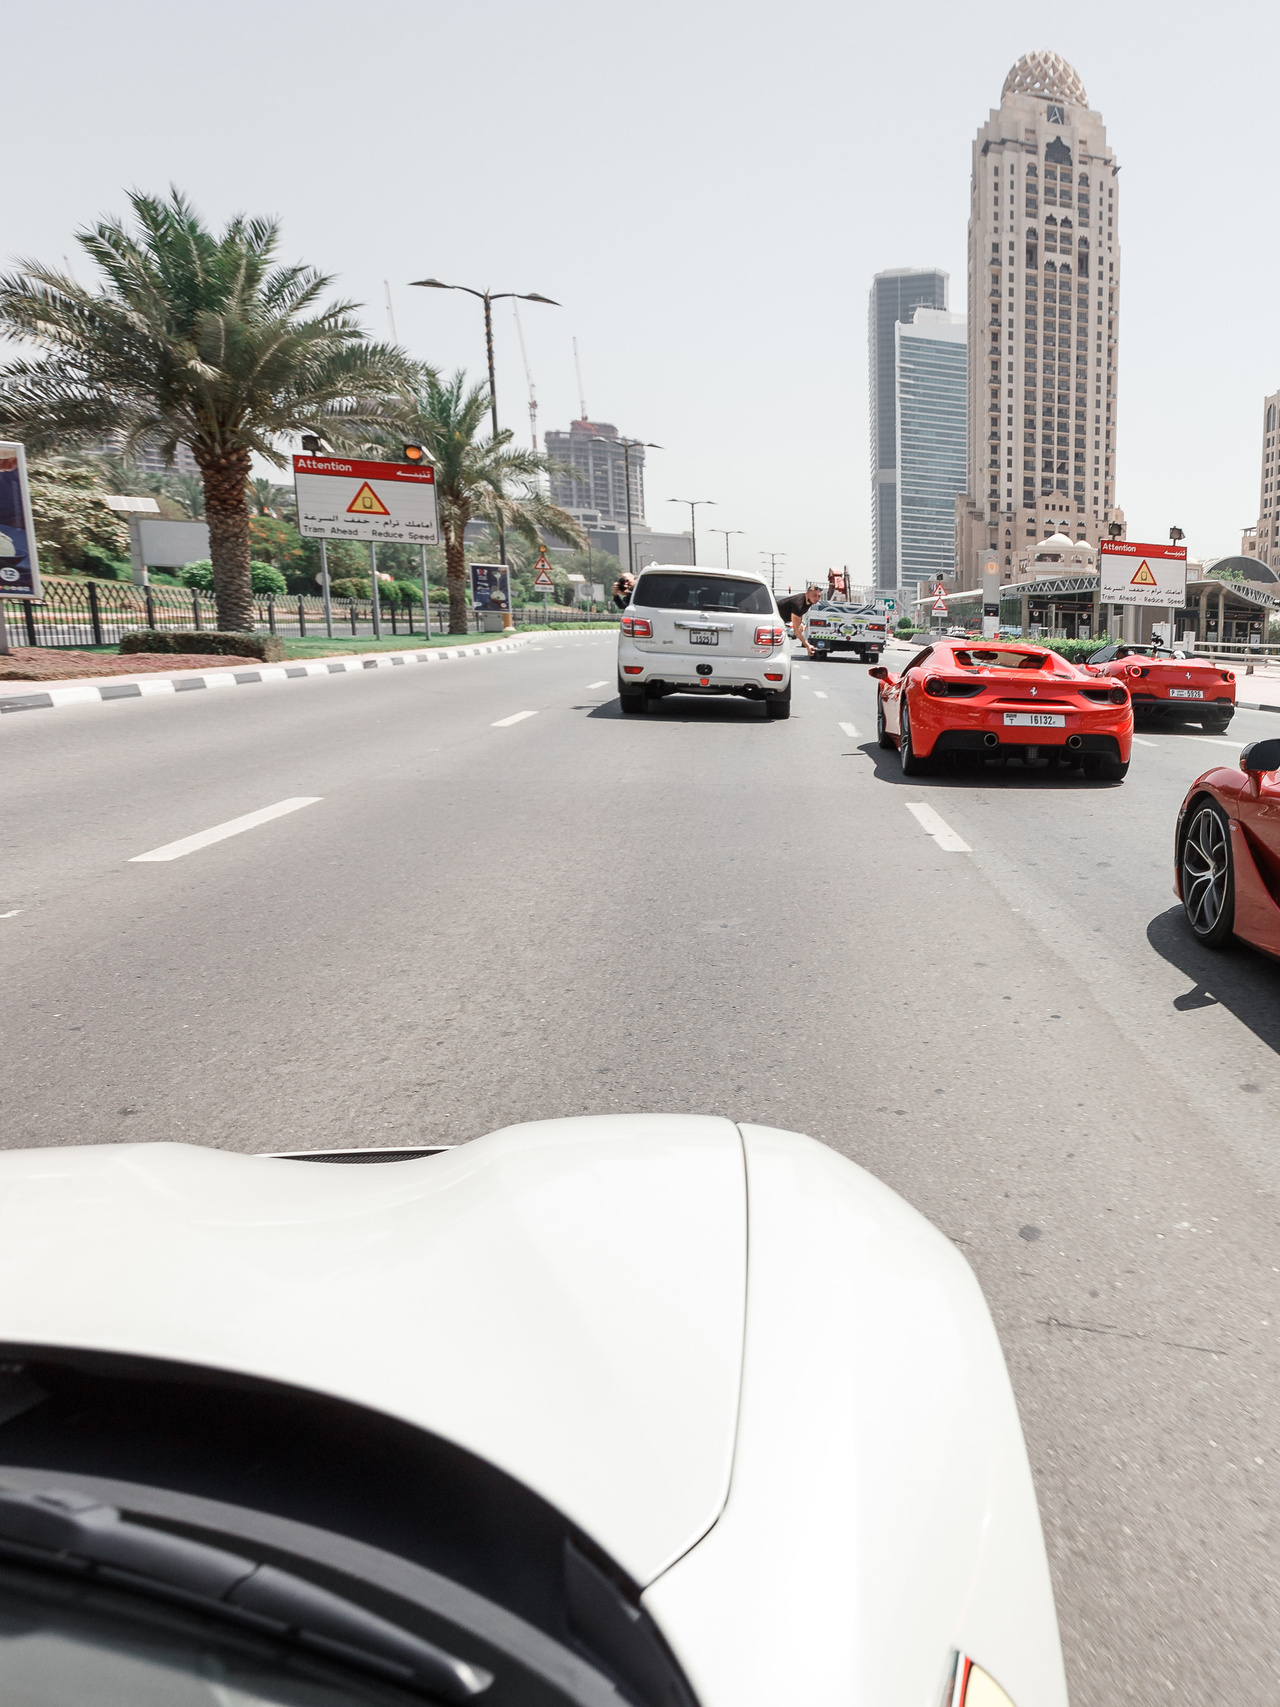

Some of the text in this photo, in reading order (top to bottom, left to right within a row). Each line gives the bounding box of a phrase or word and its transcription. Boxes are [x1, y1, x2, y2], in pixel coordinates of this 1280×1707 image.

[297, 458, 352, 472] Attention
[396, 470, 431, 480] تنبيه
[303, 513, 339, 523] السرعة
[303, 525, 325, 534] Tram
[330, 526, 358, 536] Ahead
[371, 530, 404, 539] Reduce
[408, 532, 435, 541] Speed
[1102, 543, 1137, 552] Attention
[1118, 594, 1137, 602] Ahead
[1144, 596, 1164, 604] Reduce
[1167, 597, 1185, 605] Speed
[1030, 715, 1053, 725] 16132
